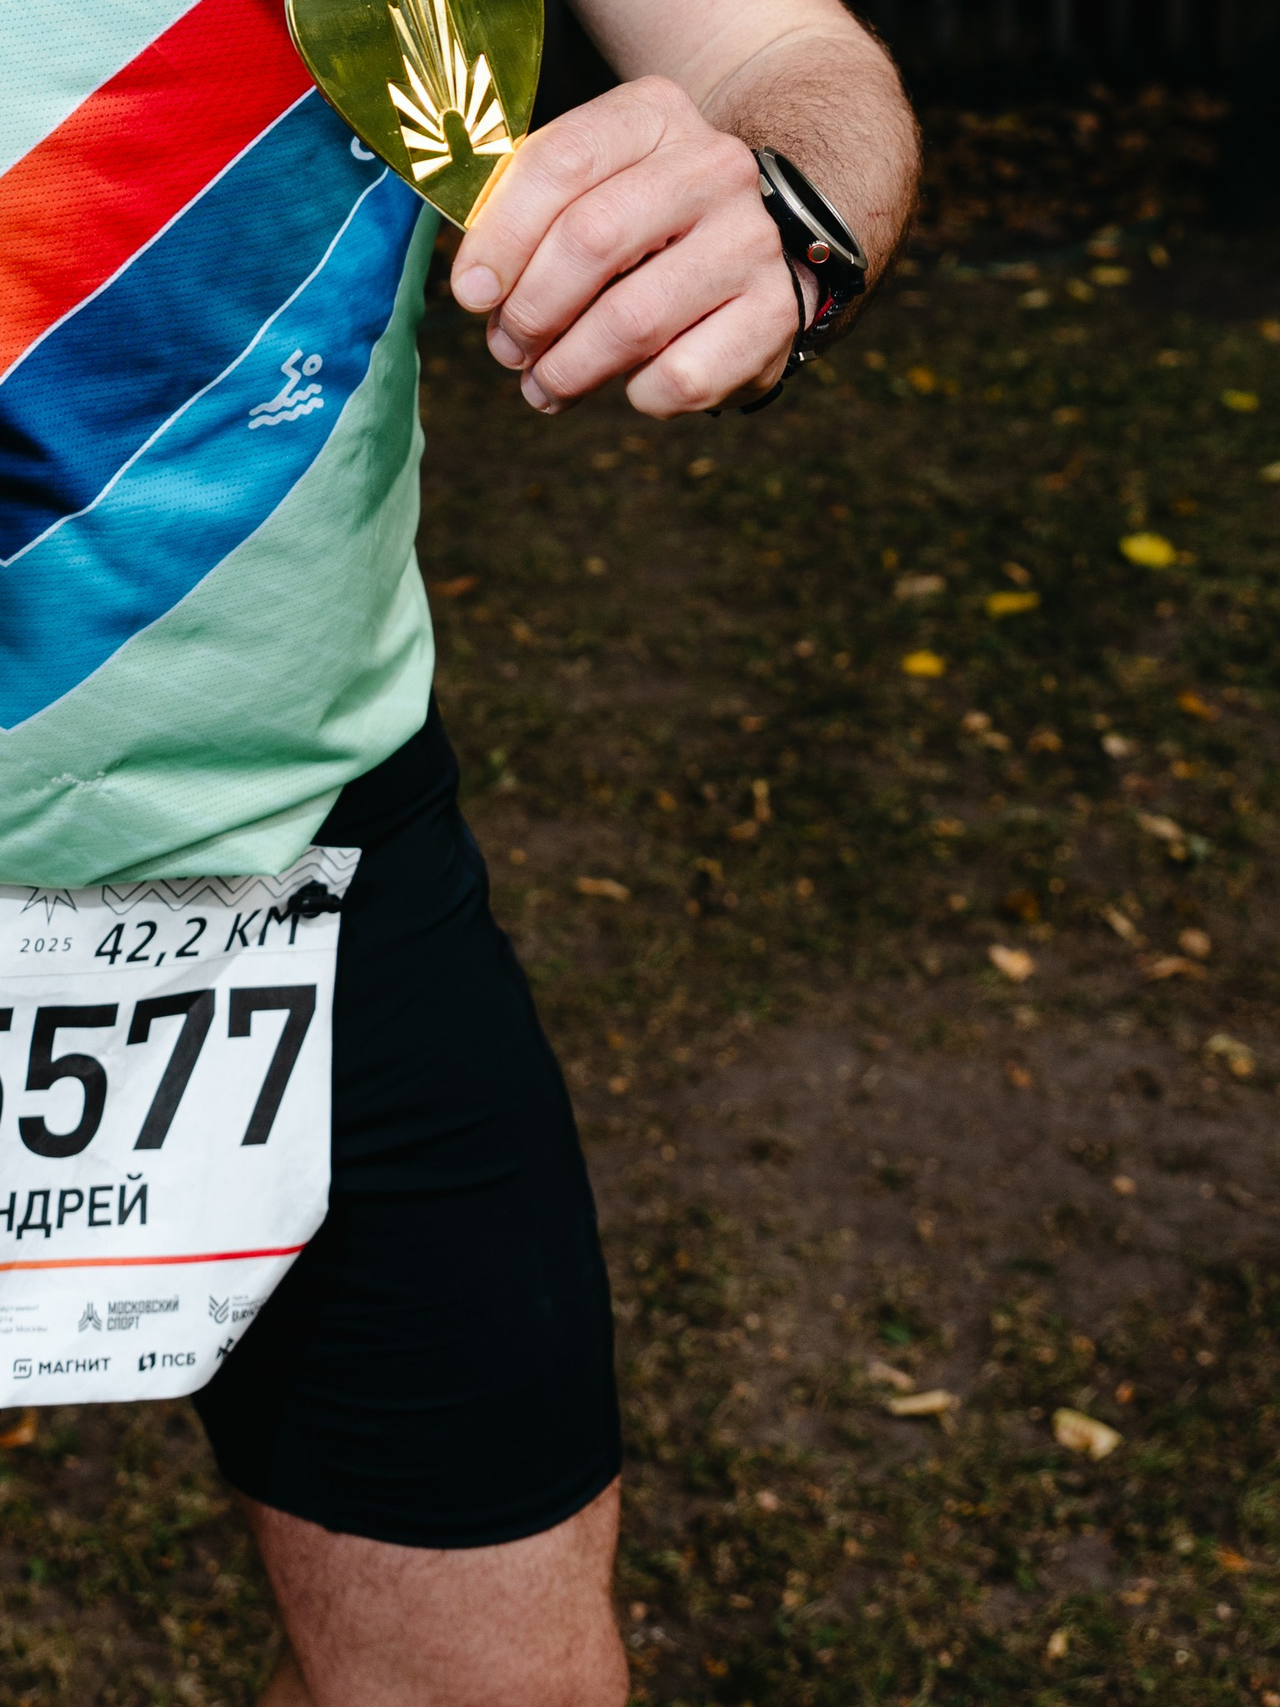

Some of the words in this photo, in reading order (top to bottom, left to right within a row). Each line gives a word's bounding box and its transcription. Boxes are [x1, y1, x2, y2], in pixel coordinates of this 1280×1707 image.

[19, 937, 74, 953] 2025
[94, 917, 208, 967] 42,2
[107, 1295, 180, 1314] МОСКОВСКИЙ
[106, 1316, 140, 1332] СПОРТ
[38, 1358, 111, 1375] МАГНИТ
[162, 1352, 196, 1368] ПСБ
